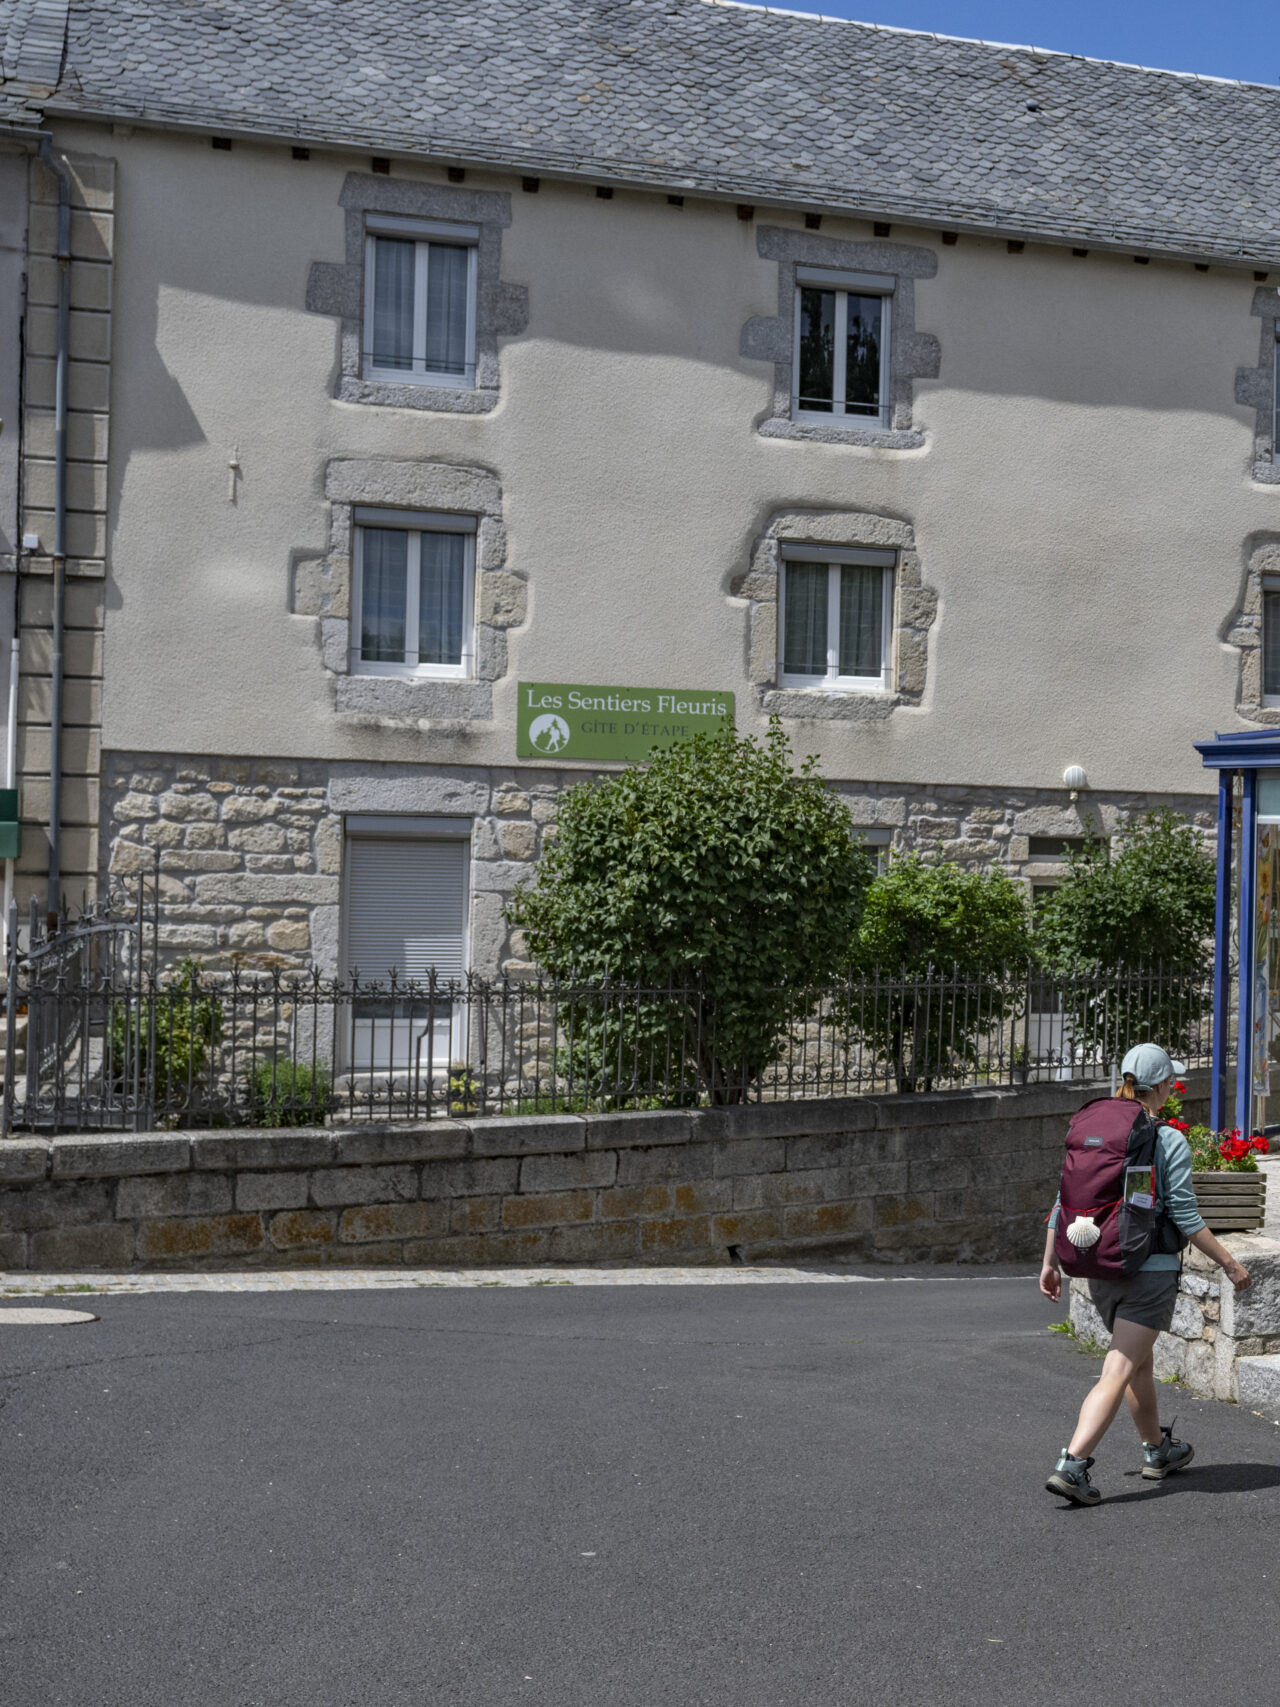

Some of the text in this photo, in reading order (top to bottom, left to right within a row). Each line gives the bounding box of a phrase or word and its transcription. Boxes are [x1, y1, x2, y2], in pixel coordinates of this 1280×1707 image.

[527, 689, 727, 716] Les Sentiers Fleuris
[581, 719, 689, 737] GÎTE D'ÉTAPE
